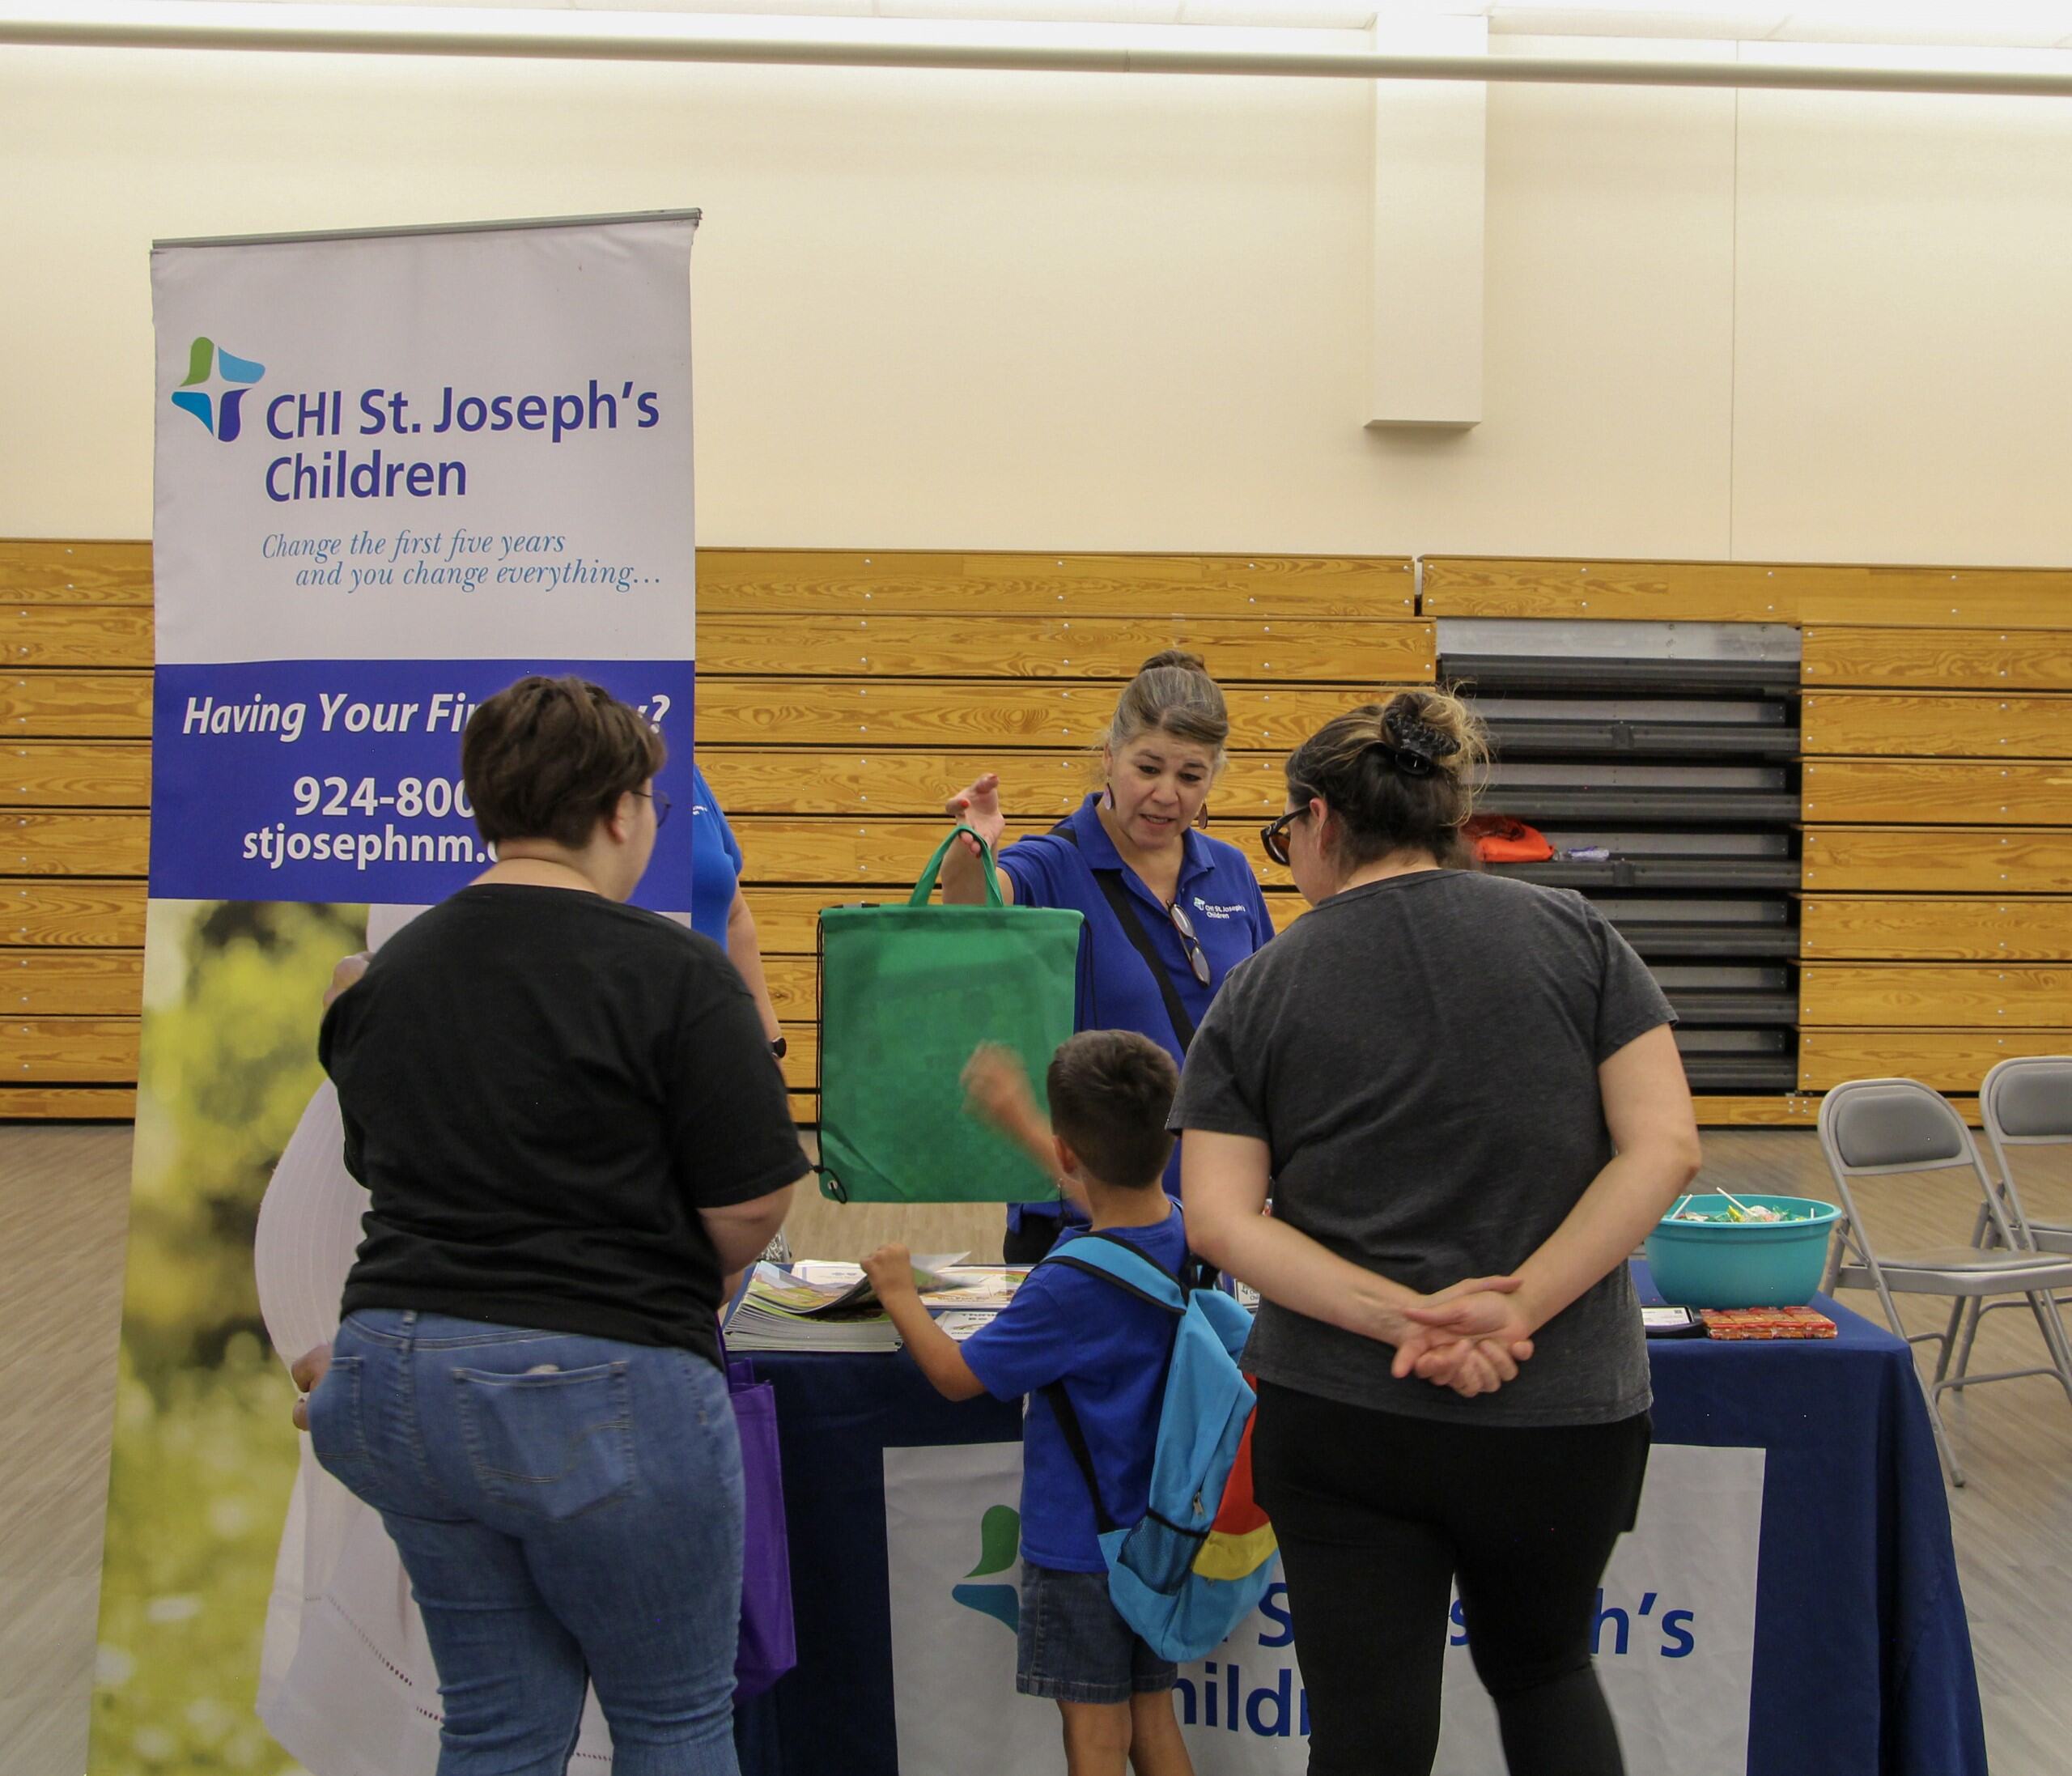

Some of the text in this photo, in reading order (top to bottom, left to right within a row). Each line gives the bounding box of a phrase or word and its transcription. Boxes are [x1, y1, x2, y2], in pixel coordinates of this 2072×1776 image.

[265, 379, 660, 444] CHI St. Joseph's
[265, 448, 467, 503] Children
[261, 528, 566, 564] Change the first five years
[295, 560, 343, 587] and
[347, 568, 395, 593] you
[402, 559, 489, 593] change
[182, 693, 307, 743] Having
[318, 692, 420, 733] Your
[292, 775, 476, 818] 924-800
[1206, 911, 1230, 920] Children
